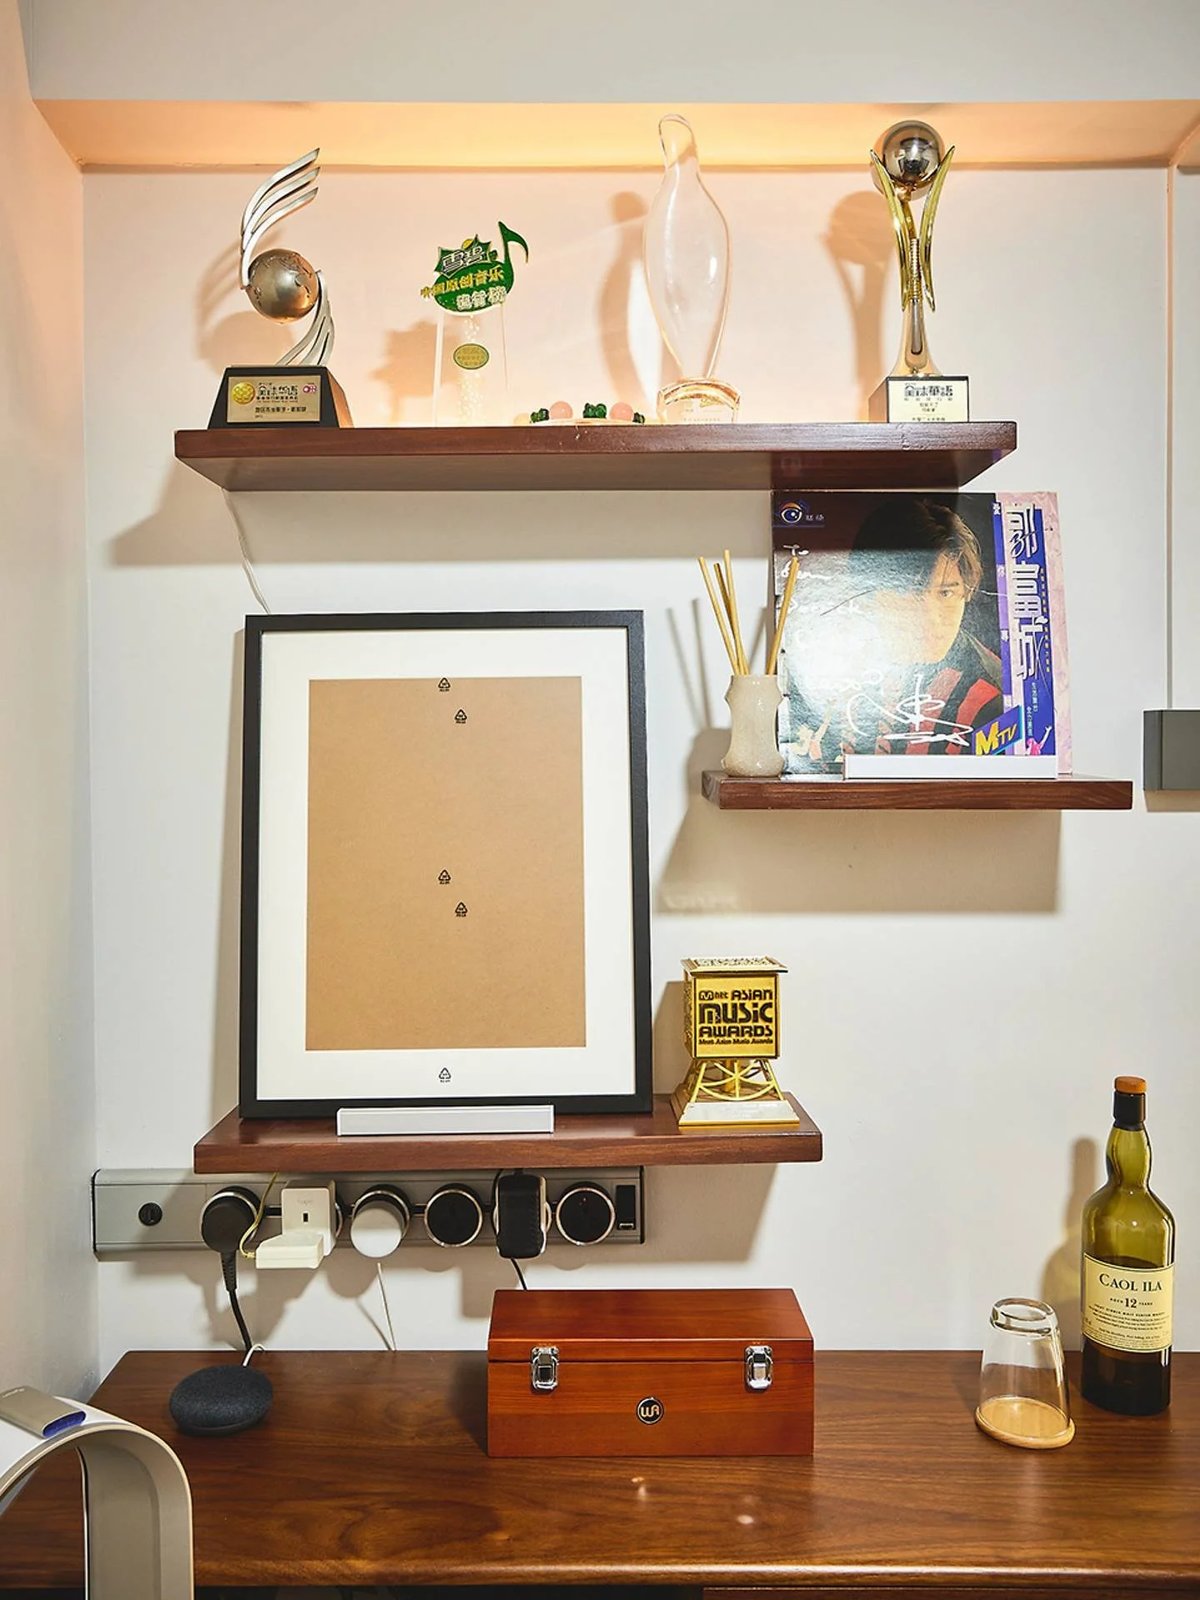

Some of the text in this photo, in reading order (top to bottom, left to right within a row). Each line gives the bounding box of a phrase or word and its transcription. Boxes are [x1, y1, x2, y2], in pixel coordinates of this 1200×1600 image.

[974, 720, 1018, 756] MTV
[698, 1002, 774, 1025] MUSIC
[698, 1025, 774, 1038] AWARDS
[1099, 1273, 1162, 1292] CAOL ILA
[1124, 1297, 1138, 1309] 12
